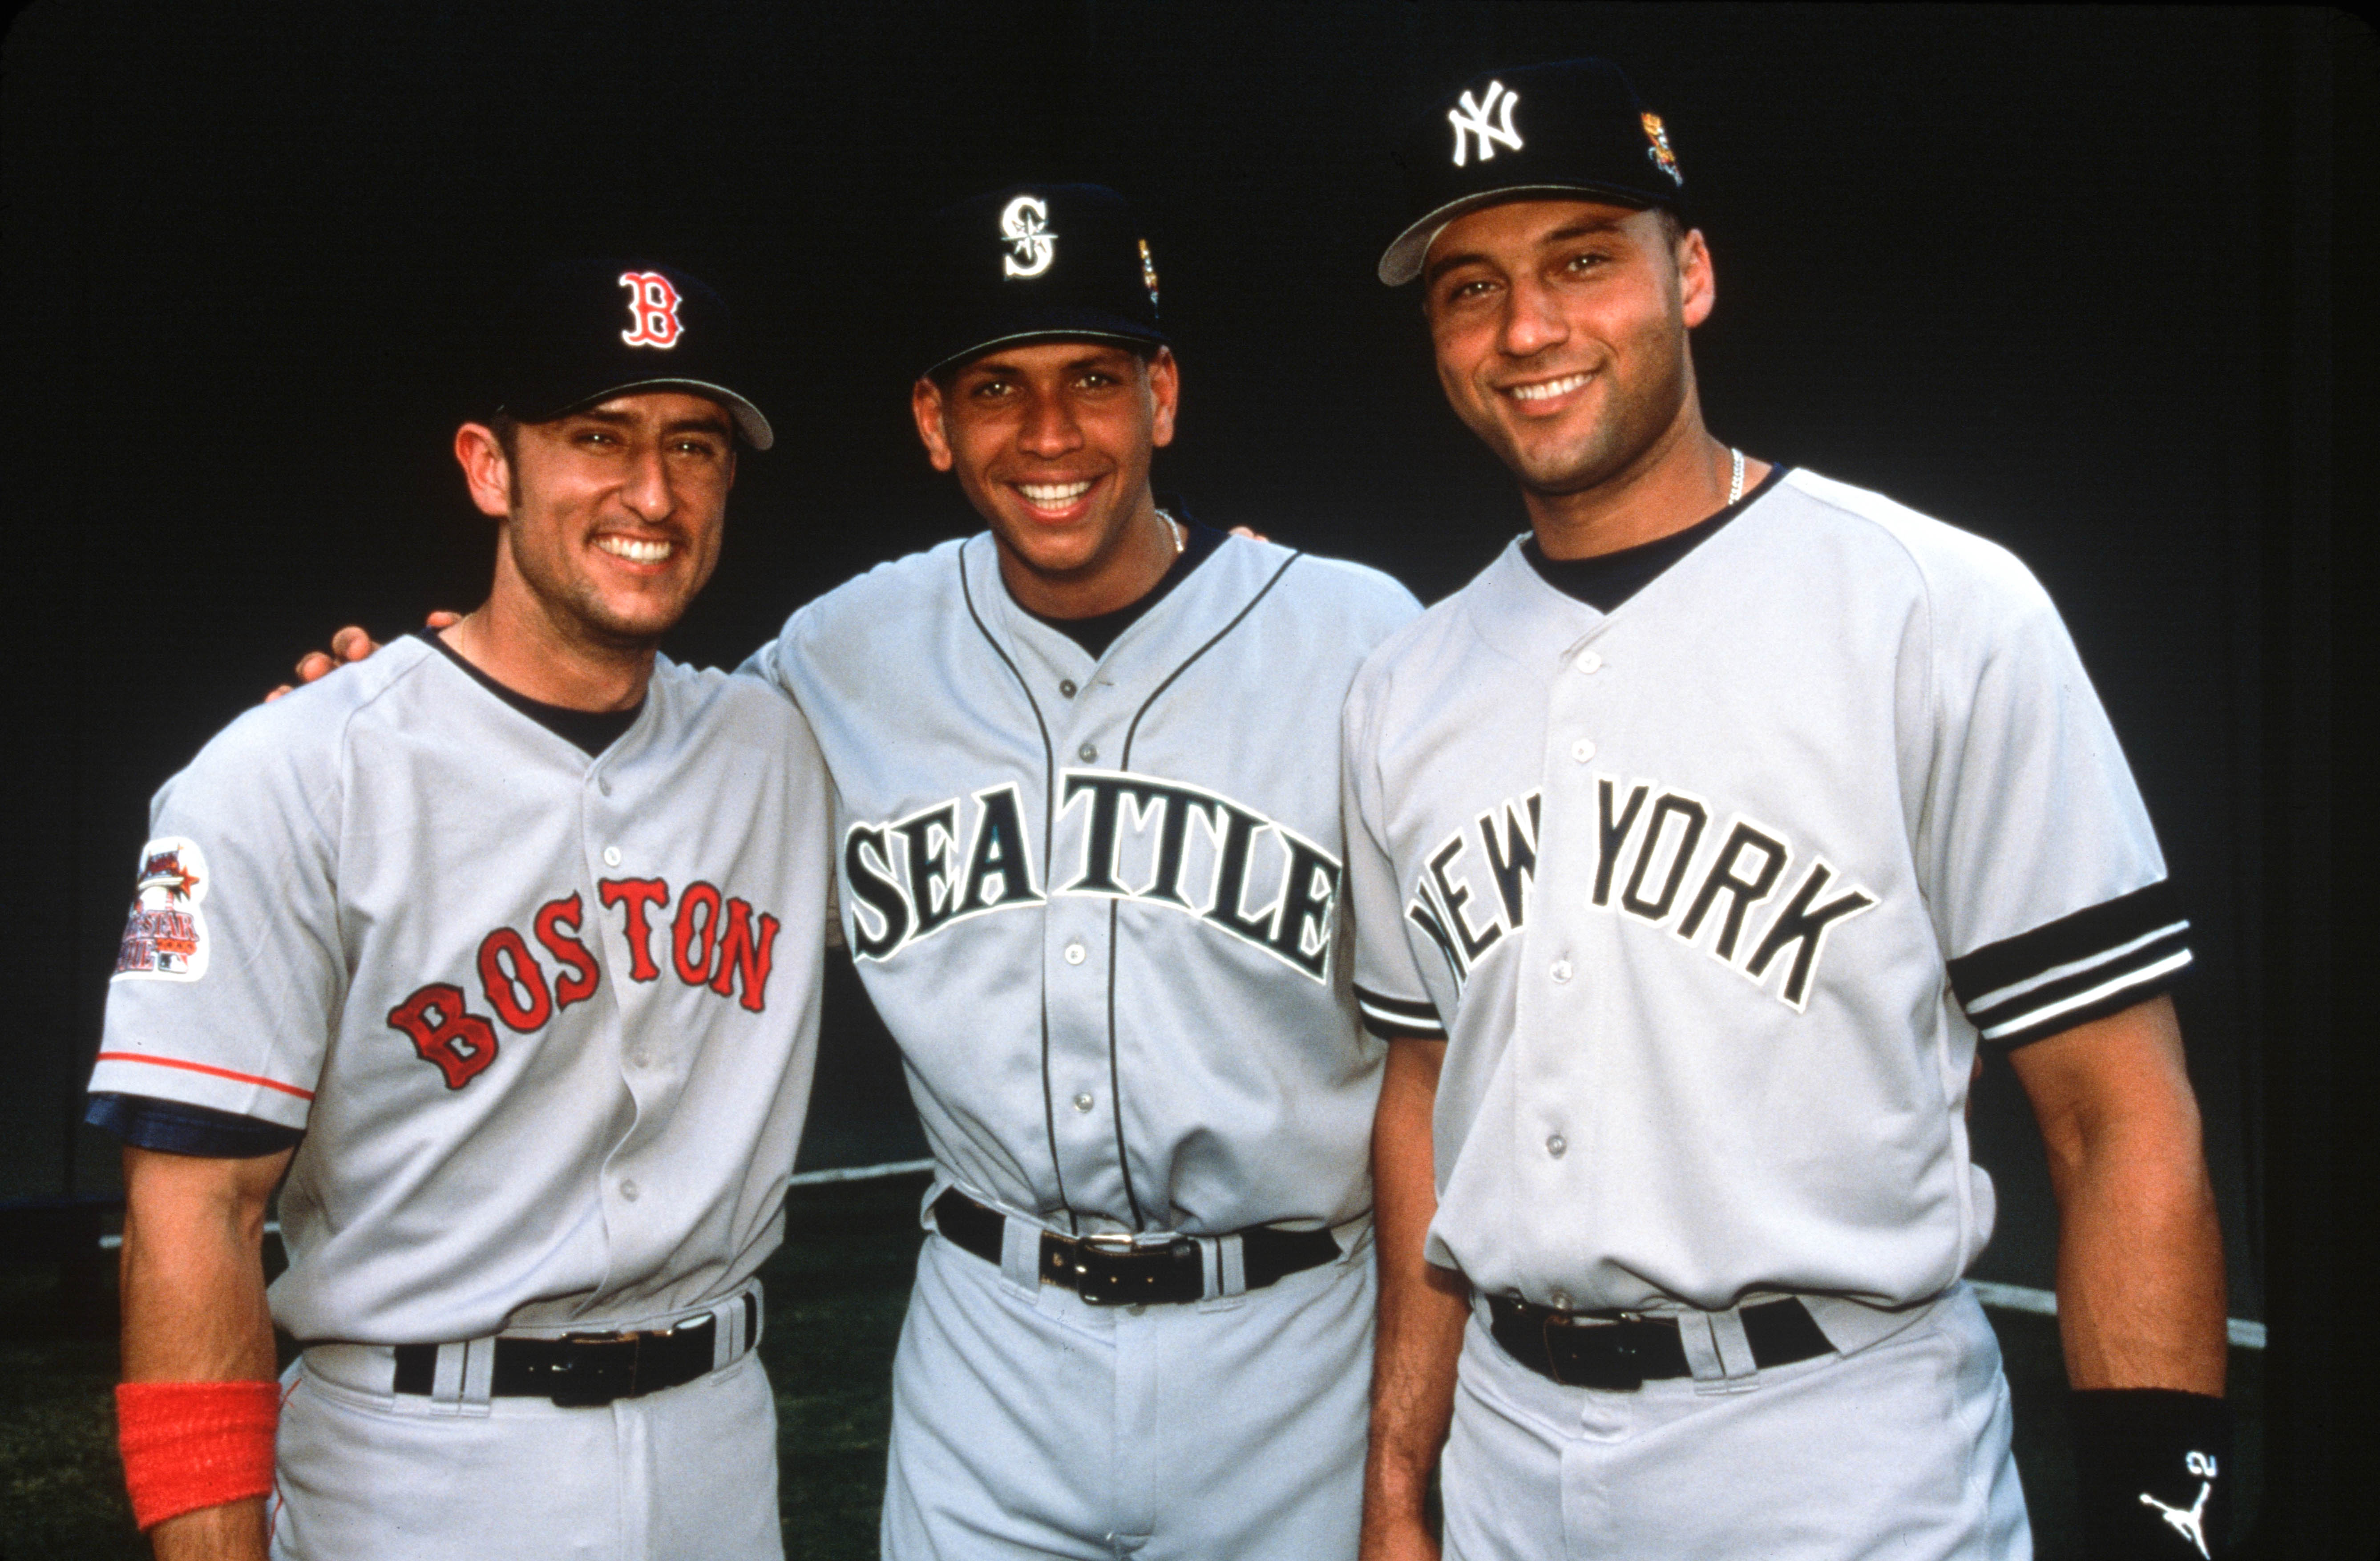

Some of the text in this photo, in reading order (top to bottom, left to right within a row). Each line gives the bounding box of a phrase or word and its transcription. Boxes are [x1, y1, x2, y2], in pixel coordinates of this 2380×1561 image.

[1449, 80, 1523, 167] NY
[1001, 196, 1059, 281] S
[619, 271, 684, 348] B
[845, 767, 1342, 985] SEATTLE
[1405, 771, 1881, 1014] NEW YORK
[386, 877, 781, 1091] BOSTON
[2186, 1449, 2218, 1479] 2
